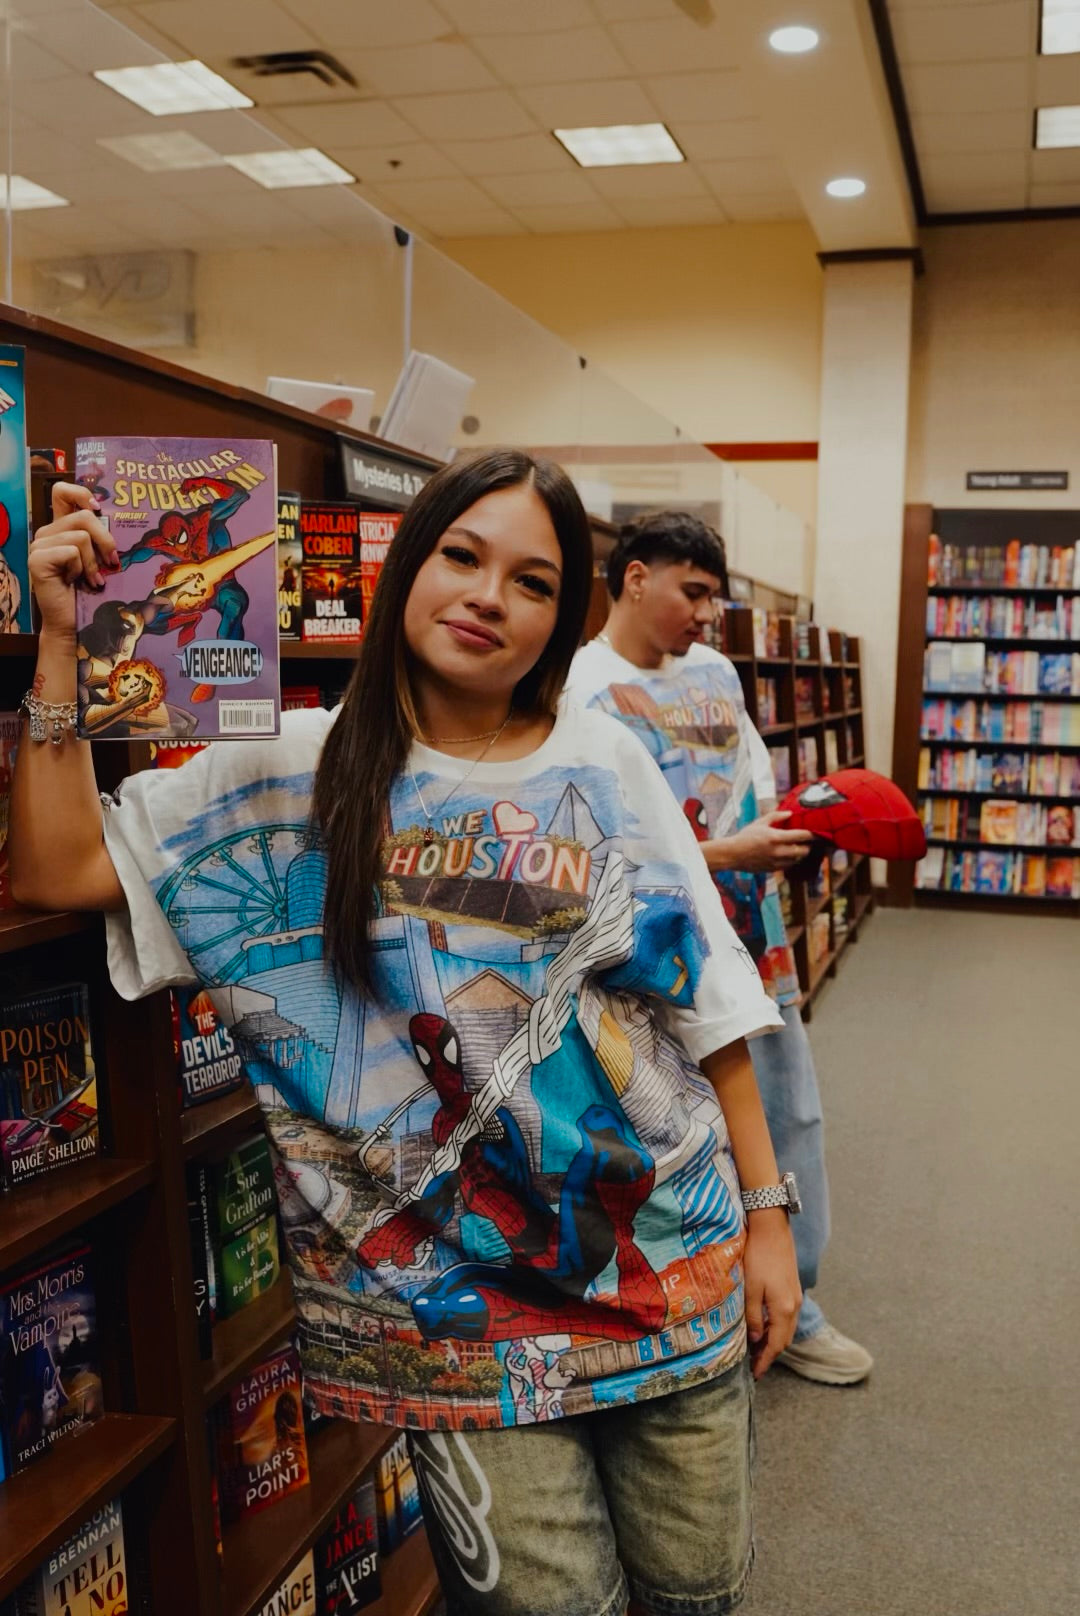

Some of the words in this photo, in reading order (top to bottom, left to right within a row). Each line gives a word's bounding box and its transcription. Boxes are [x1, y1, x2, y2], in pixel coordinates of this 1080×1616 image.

[76, 441, 106, 456] MARVEL
[115, 449, 243, 481] SPECTACULAR
[113, 461, 267, 511] SPIDER-N
[353, 458, 402, 493] Mysteries
[403, 473, 413, 496] &
[300, 513, 358, 534] HARLAN
[360, 521, 397, 542] ATRICIA
[303, 535, 353, 556] COBEN
[303, 617, 361, 637] BREAKER
[315, 599, 347, 617] DEAL
[442, 809, 488, 835] WE
[386, 835, 592, 895] HOUSTON
[0, 1016, 88, 1063] POISON
[194, 1010, 217, 1033] THE
[181, 1026, 235, 1069] DEVIL'S
[23, 1051, 69, 1089] PEN
[182, 1055, 242, 1095] TEARDROP
[11, 1151, 44, 1175] PAIGE
[48, 1135, 96, 1162] SHELTON
[236, 1170, 259, 1195] Sue
[225, 1186, 273, 1225] Grafton
[10, 1291, 36, 1321] Mrs.
[37, 1261, 85, 1305] Morris
[24, 1304, 42, 1325] and
[637, 1332, 674, 1363] BE
[236, 1371, 297, 1412] GRIFFIN
[241, 1360, 291, 1395] LAURA
[18, 1438, 46, 1462] TRACI
[47, 1414, 84, 1443] WILTON
[248, 1447, 295, 1484] LIAR'S
[246, 1463, 301, 1508] POINT
[49, 1513, 121, 1576] BRENNAN
[325, 1517, 375, 1569] JANCE
[54, 1543, 121, 1609] TELL
[326, 1580, 337, 1596] THE
[350, 1552, 378, 1586] LIST
[89, 1571, 124, 1616] NO
